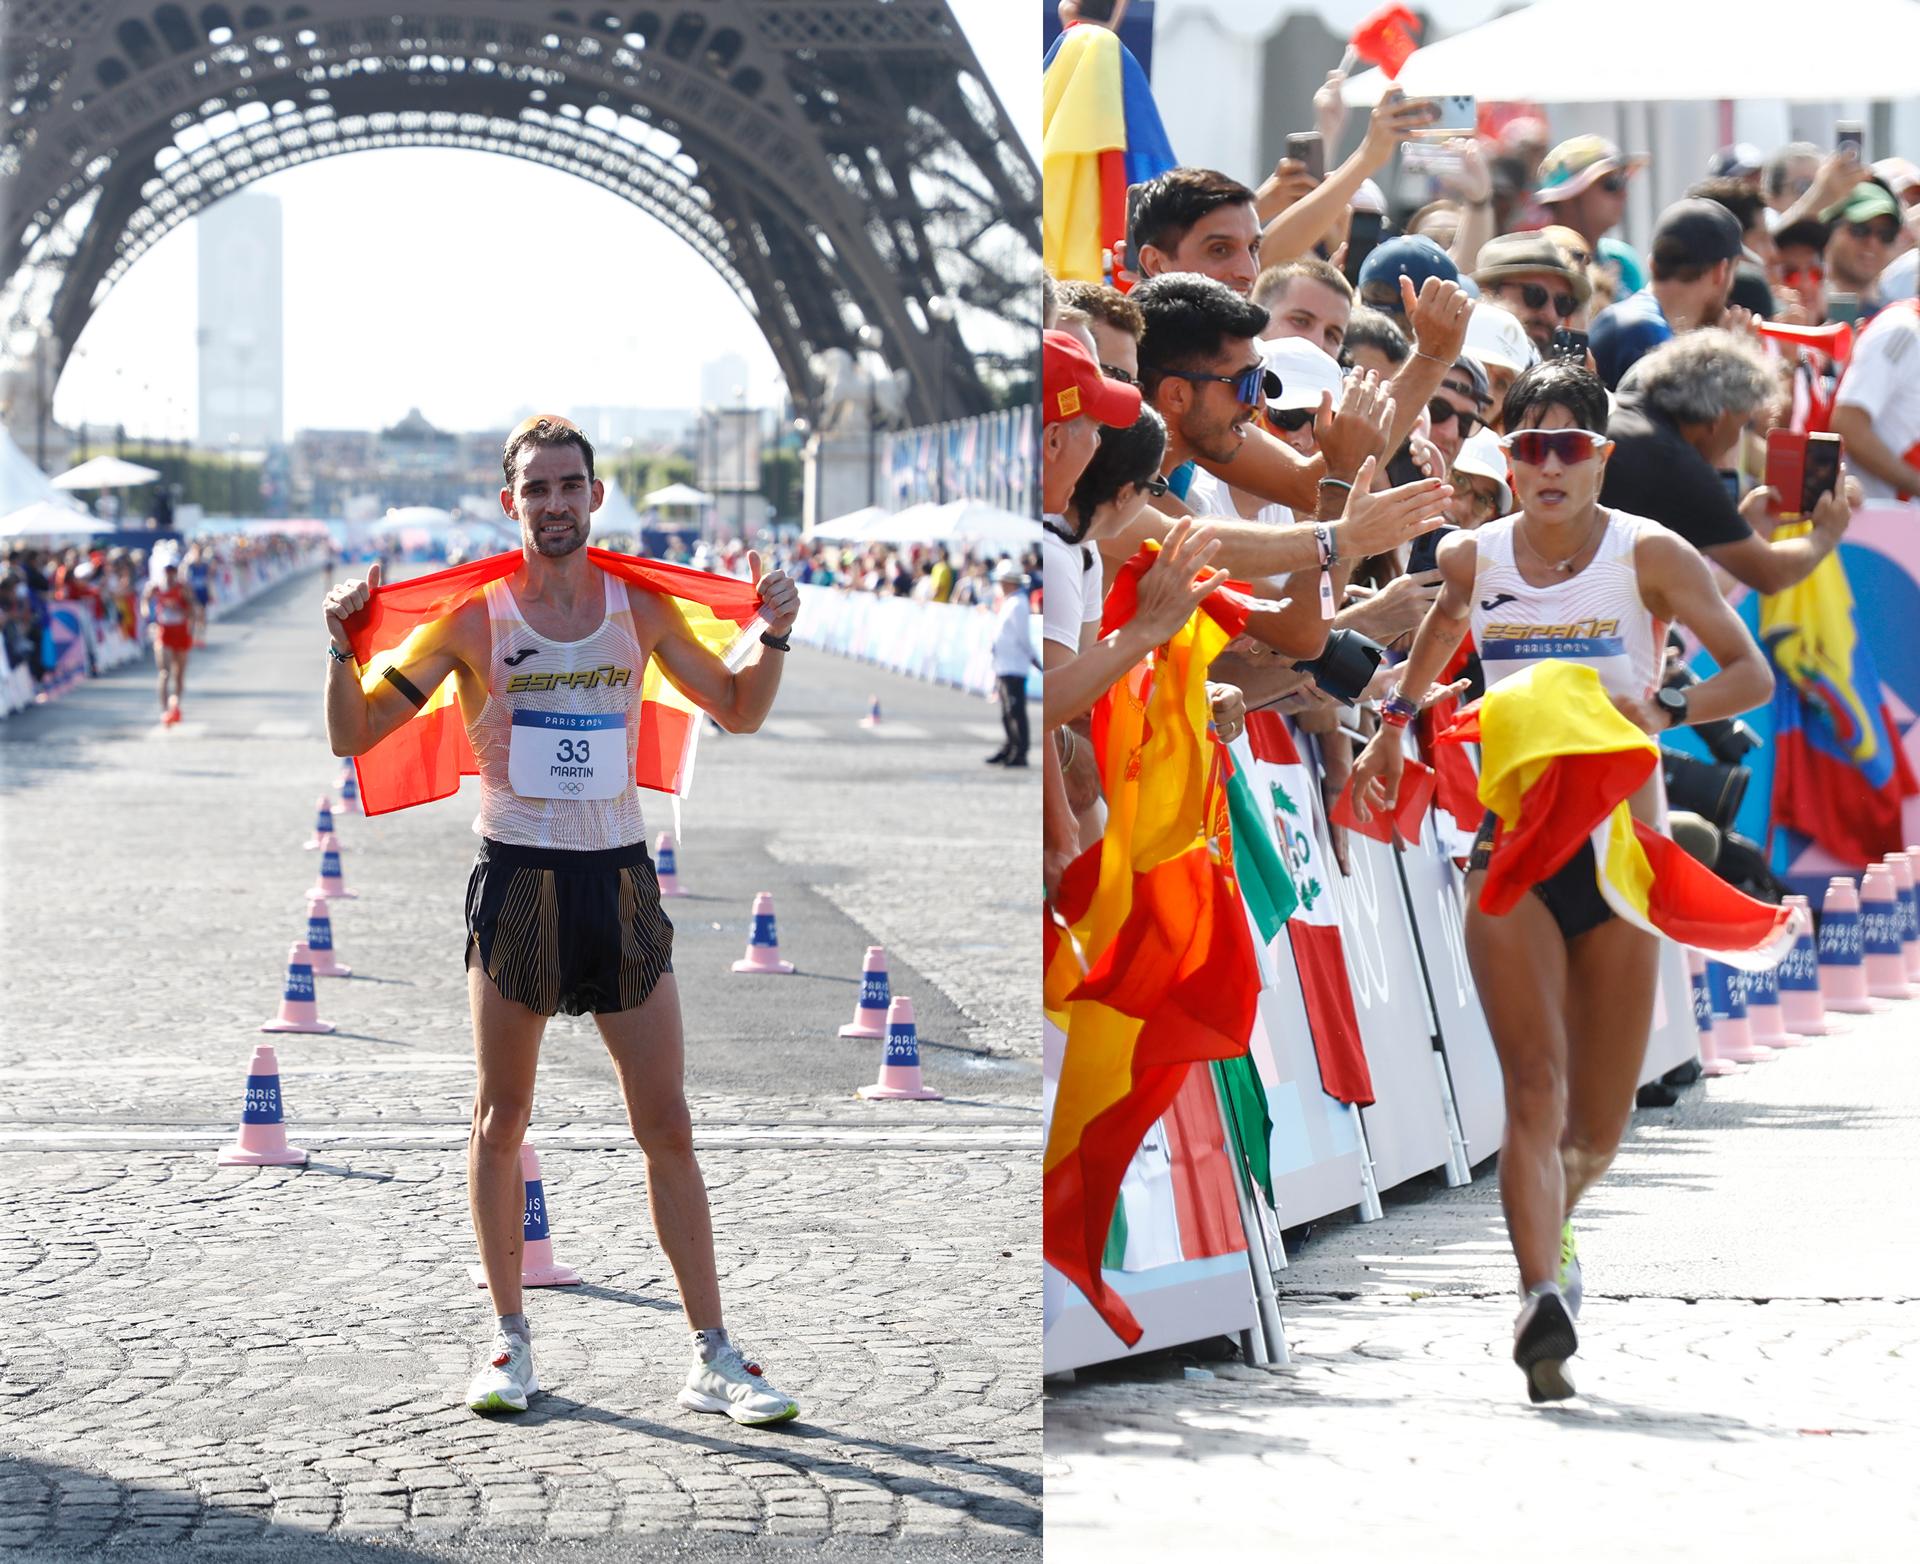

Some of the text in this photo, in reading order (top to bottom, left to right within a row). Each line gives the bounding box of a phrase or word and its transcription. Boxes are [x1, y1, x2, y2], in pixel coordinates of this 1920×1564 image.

[1482, 616, 1620, 640] ESPAÑA
[1514, 643, 1589, 654] PARIS 2024
[507, 665, 631, 693] ESPAÑA
[545, 716, 602, 727] PARIS 2024
[556, 739, 590, 763] 33
[550, 765, 594, 778] MARTIN
